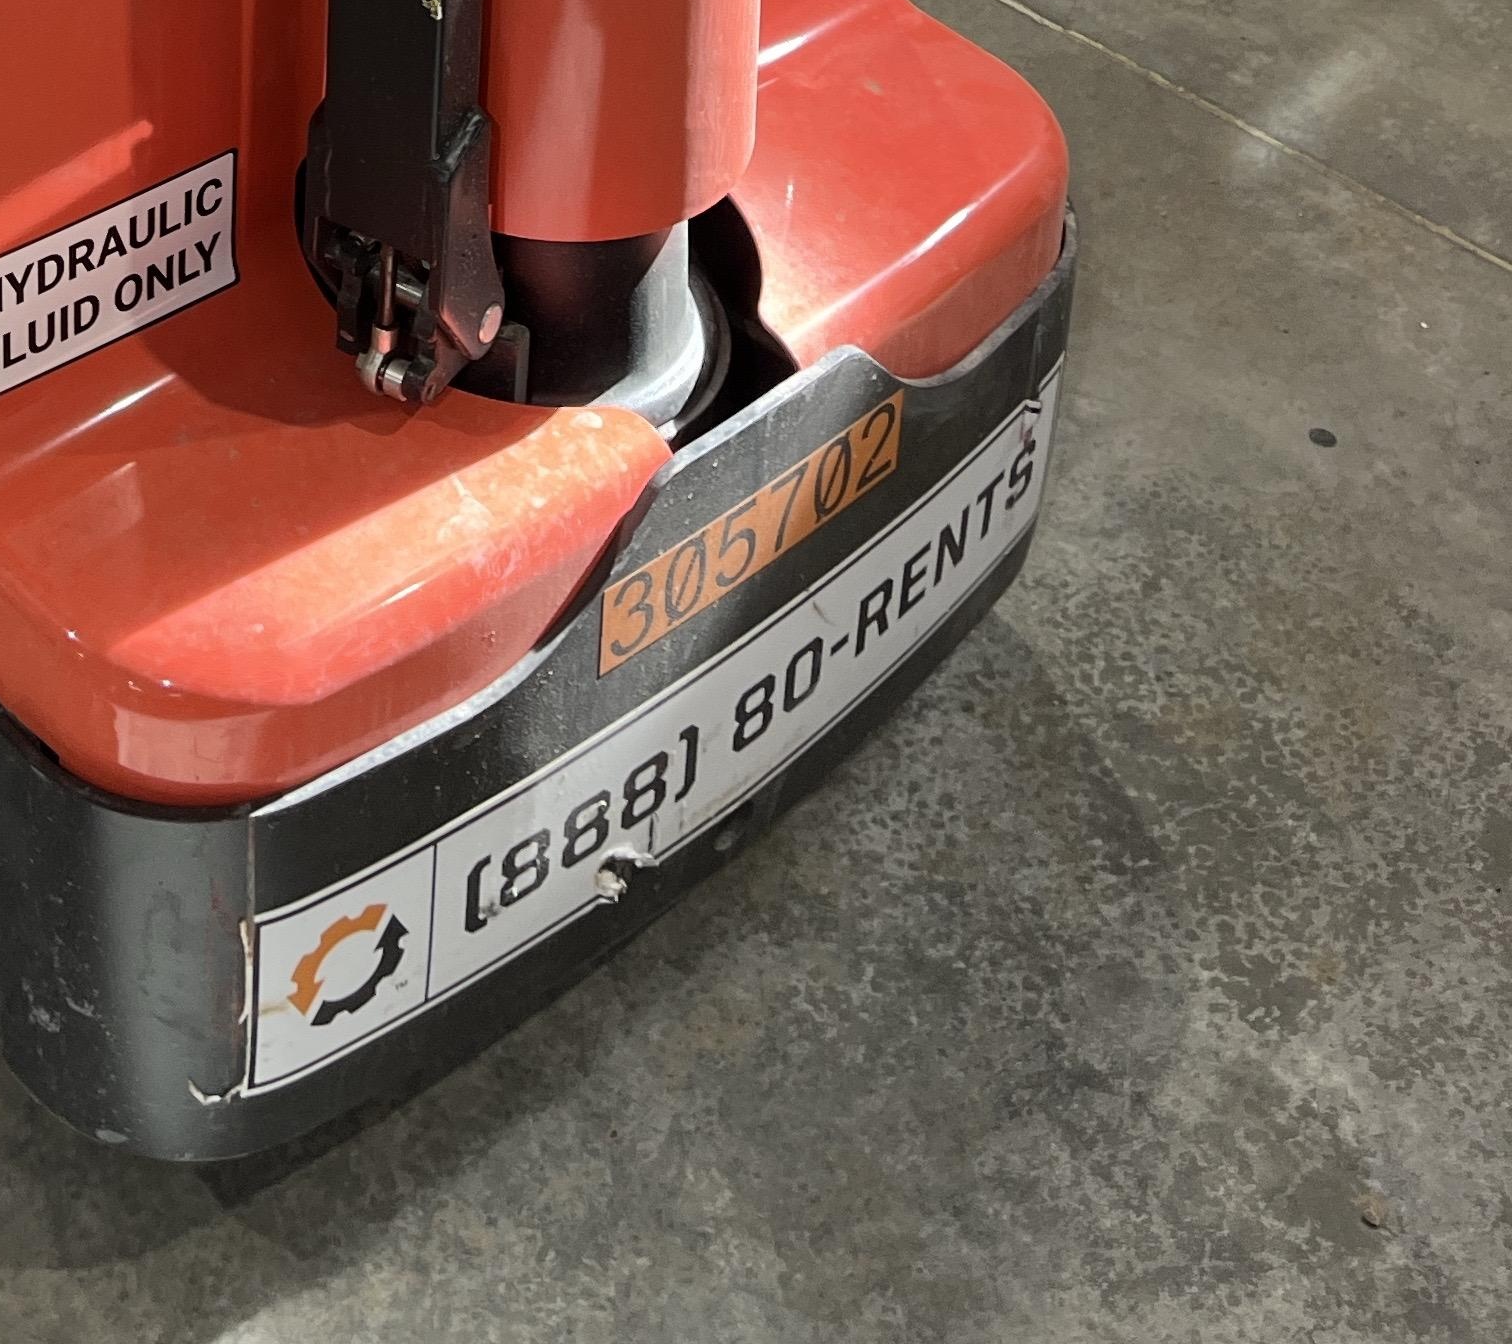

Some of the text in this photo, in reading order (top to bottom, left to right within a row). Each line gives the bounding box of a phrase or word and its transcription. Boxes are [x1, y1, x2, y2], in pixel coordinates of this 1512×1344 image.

[113, 229, 223, 312] ONLY
[609, 400, 898, 656] 305702
[464, 433, 1040, 935] (888) 80-RENTS
